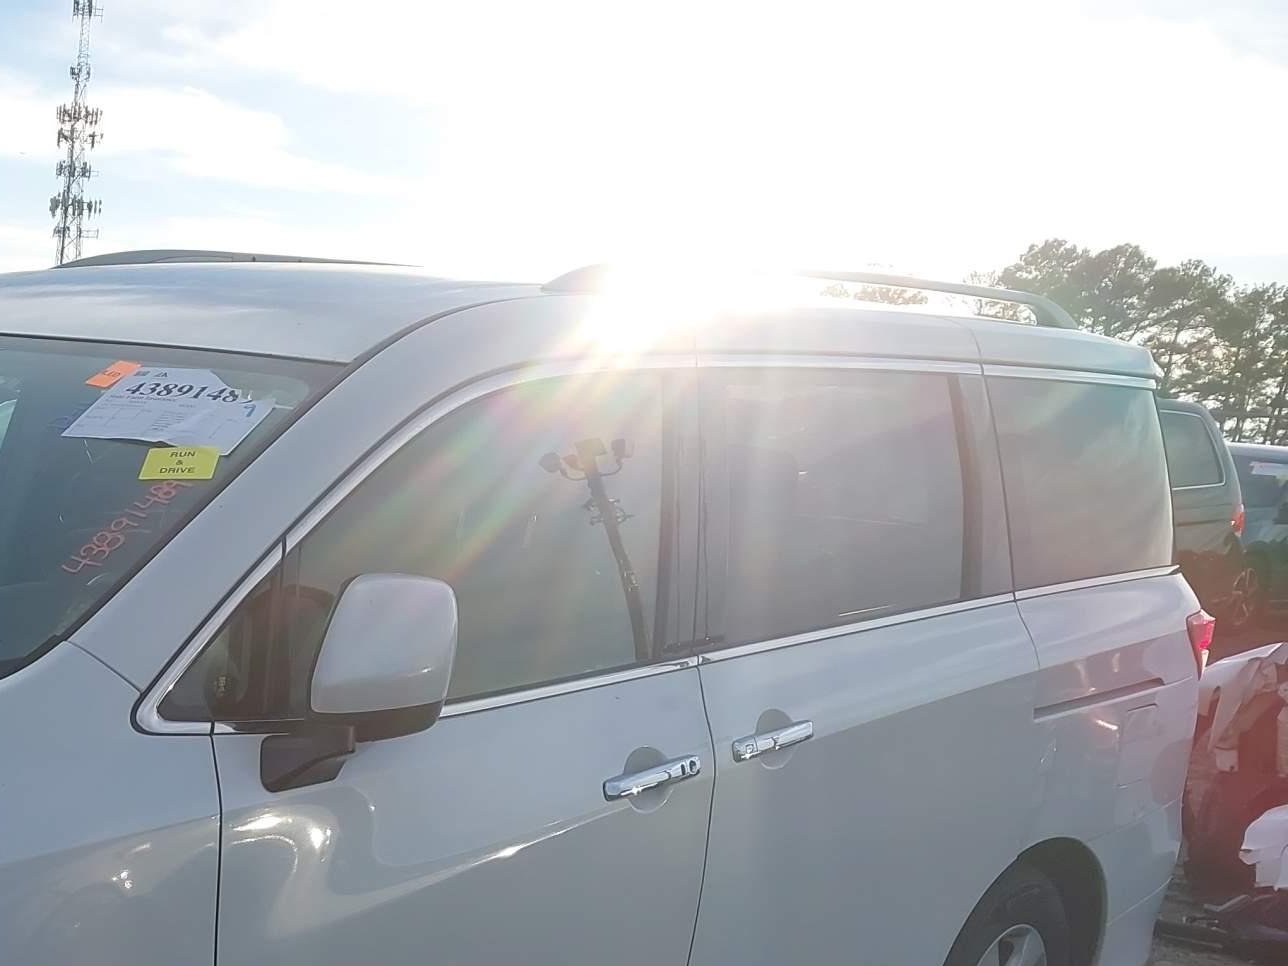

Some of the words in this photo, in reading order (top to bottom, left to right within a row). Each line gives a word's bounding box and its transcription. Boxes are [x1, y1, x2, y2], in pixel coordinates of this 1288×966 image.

[125, 382, 253, 406] 4389148
[159, 466, 196, 474] DRIVE
[61, 480, 193, 574] 43891489
